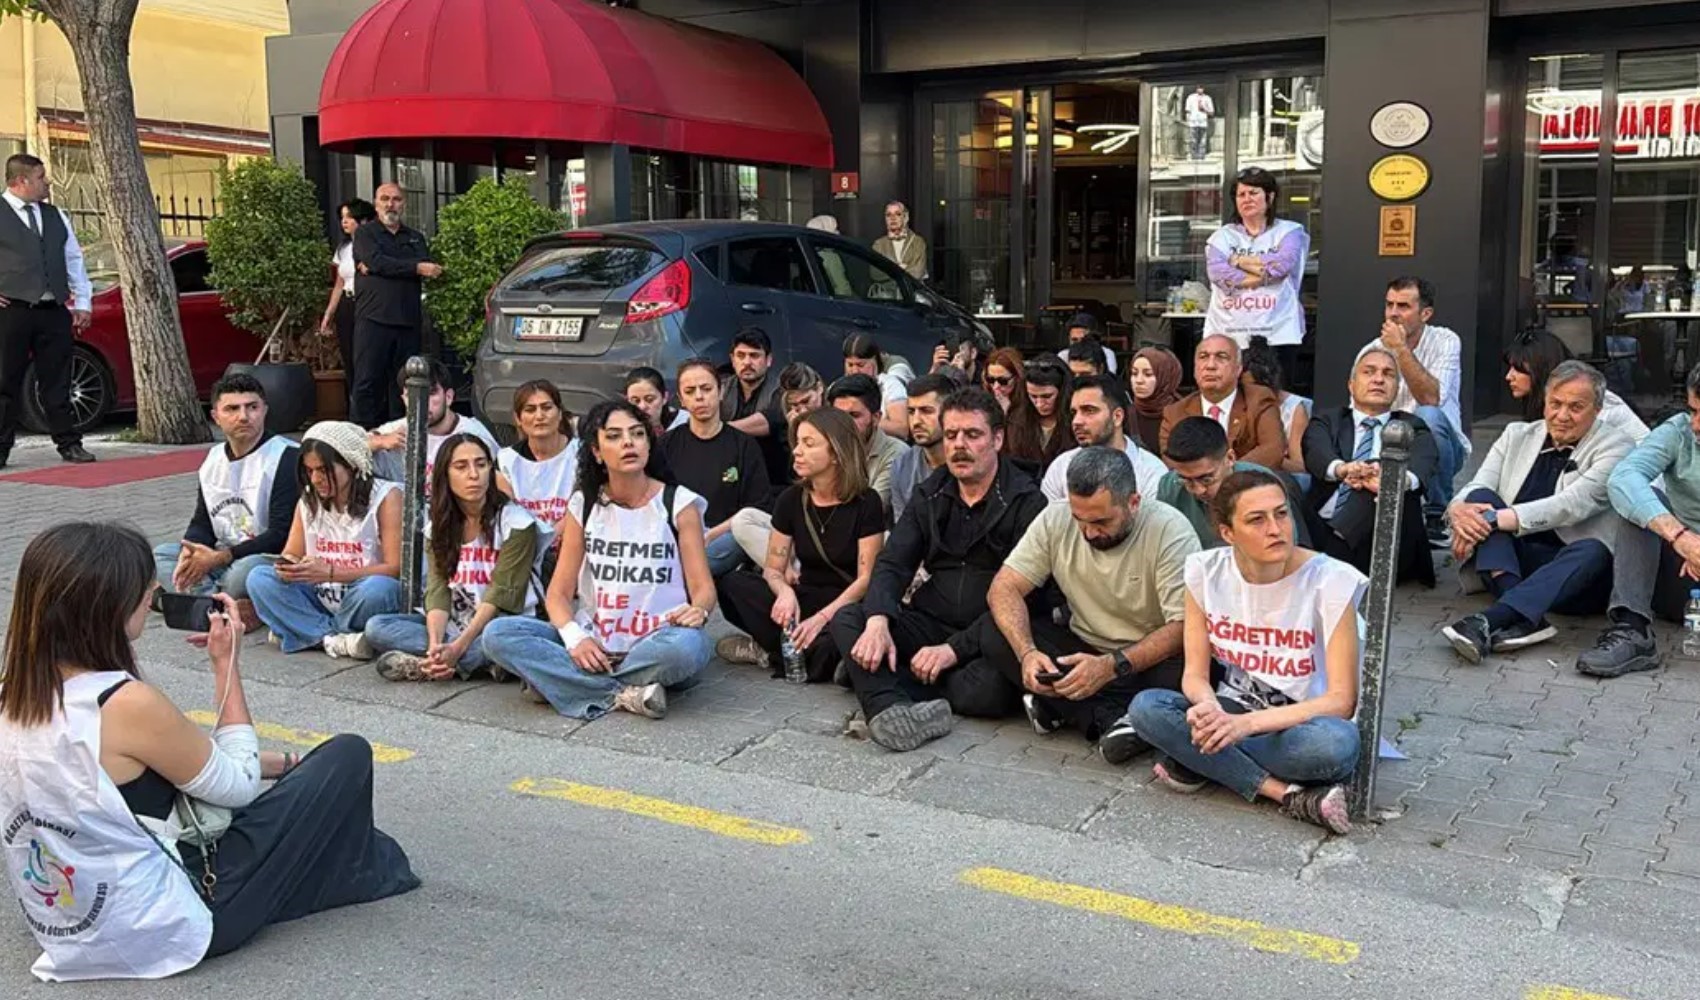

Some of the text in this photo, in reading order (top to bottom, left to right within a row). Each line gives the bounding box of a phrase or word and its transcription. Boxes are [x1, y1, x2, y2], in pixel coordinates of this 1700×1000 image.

[841, 176, 849, 189] 8
[556, 320, 580, 334] 2155
[597, 587, 629, 609] İLE
